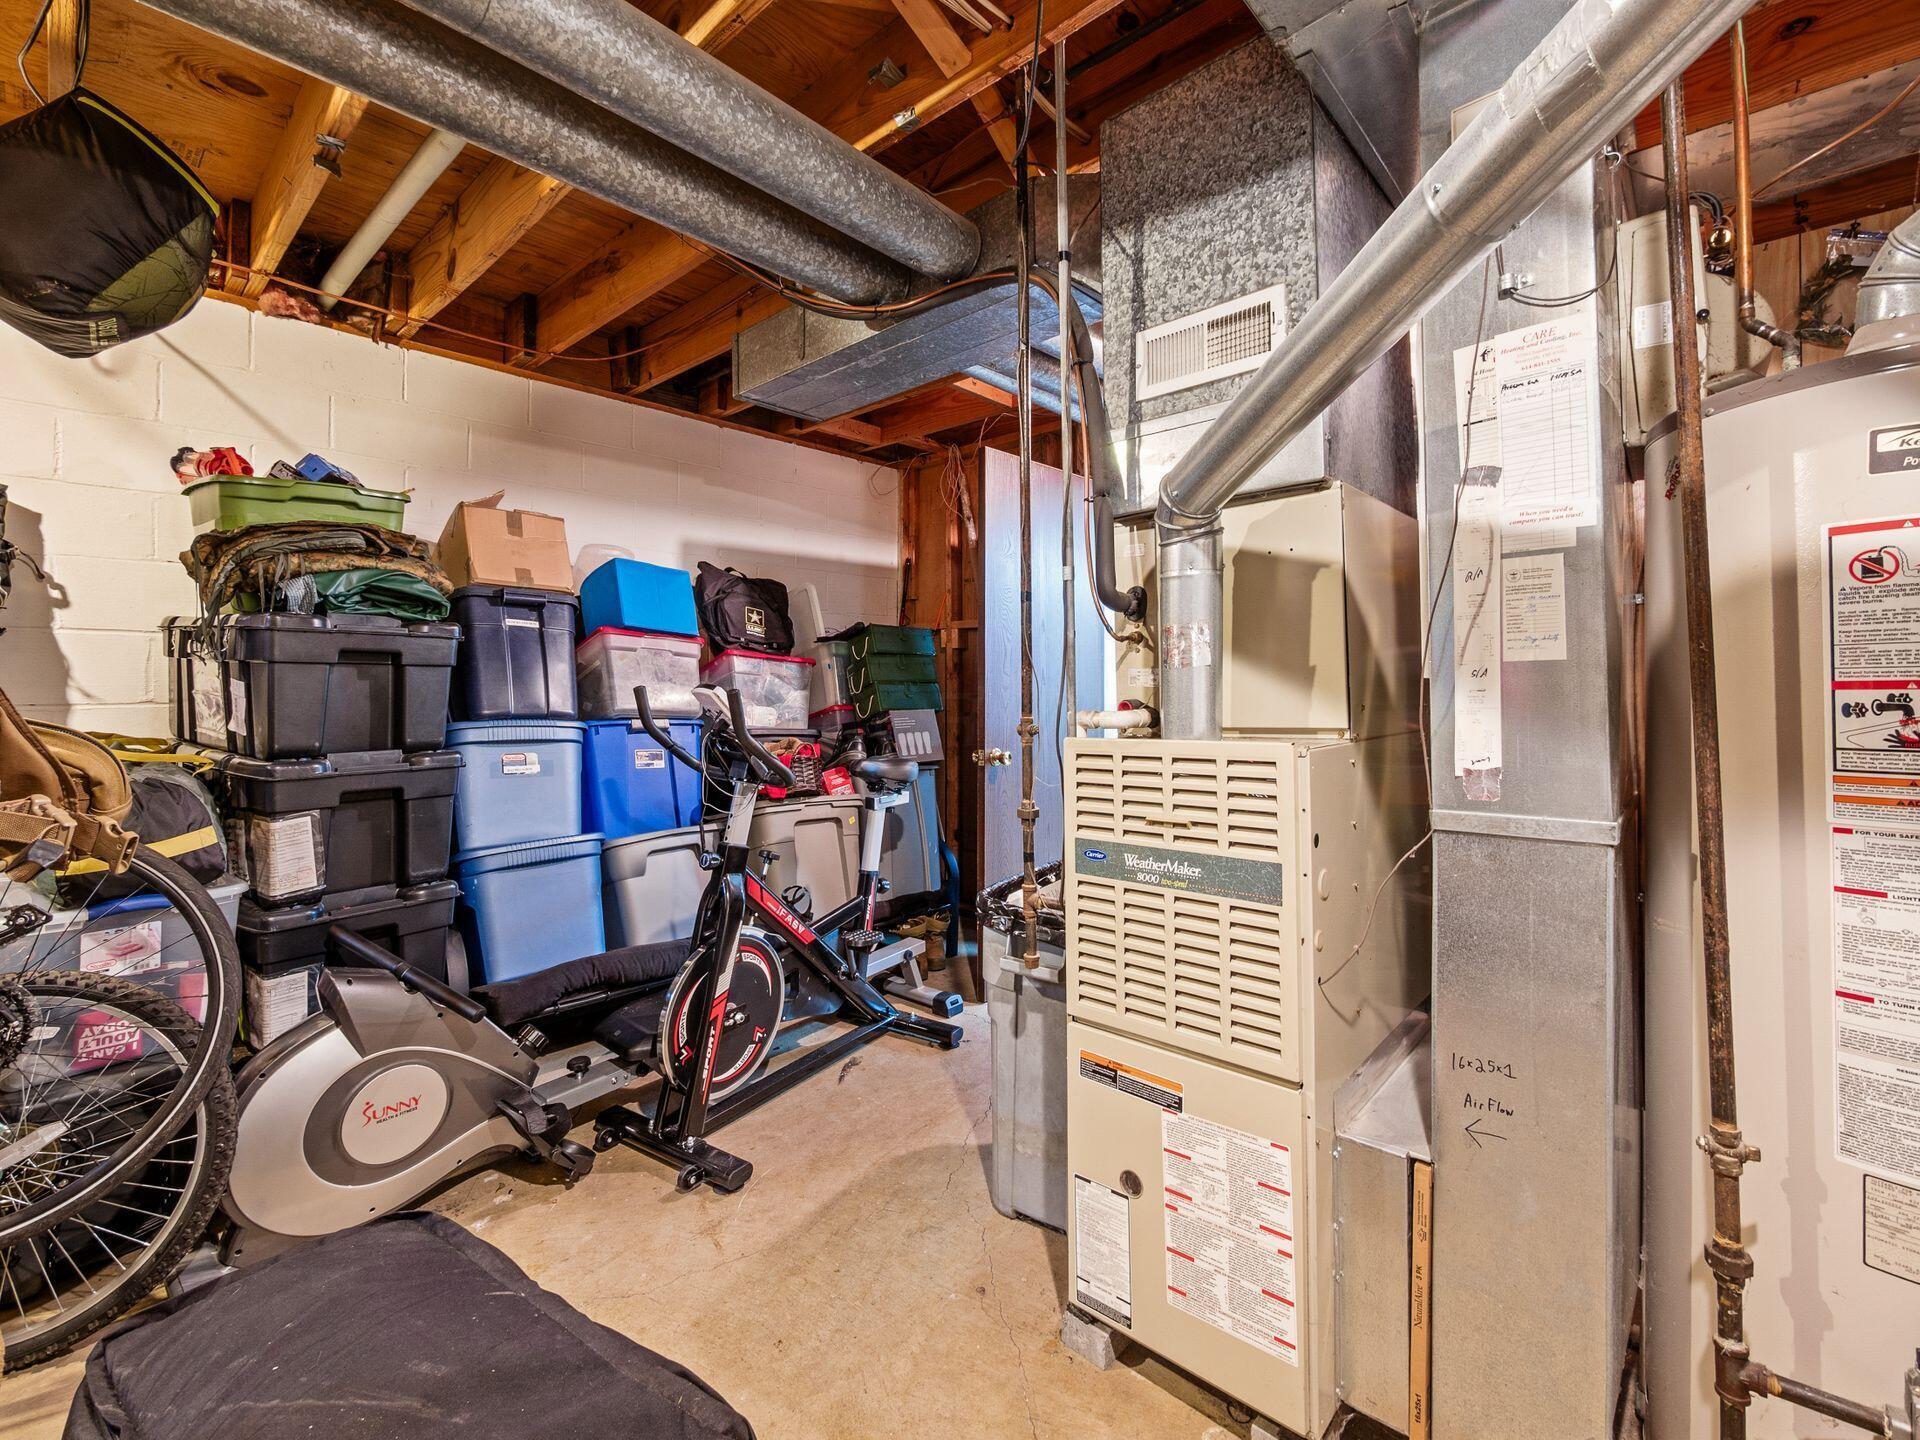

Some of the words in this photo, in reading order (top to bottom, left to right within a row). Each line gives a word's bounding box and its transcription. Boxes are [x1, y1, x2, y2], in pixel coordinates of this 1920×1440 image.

[1523, 326, 1557, 343] CARE
[1903, 456, 1920, 467] Po
[1509, 518, 1537, 526] company
[1849, 584, 1872, 592] Vapors
[1086, 849, 1105, 860] Carrier
[1124, 853, 1201, 877] WeatherMaker
[1136, 872, 1160, 884] 8000
[1892, 1001, 1915, 1010] TURN
[80, 1020, 136, 1038] ODAY
[702, 1026, 715, 1079] SPORT
[1452, 1052, 1517, 1079] 16x25x1
[362, 1094, 421, 1128] SUNNY
